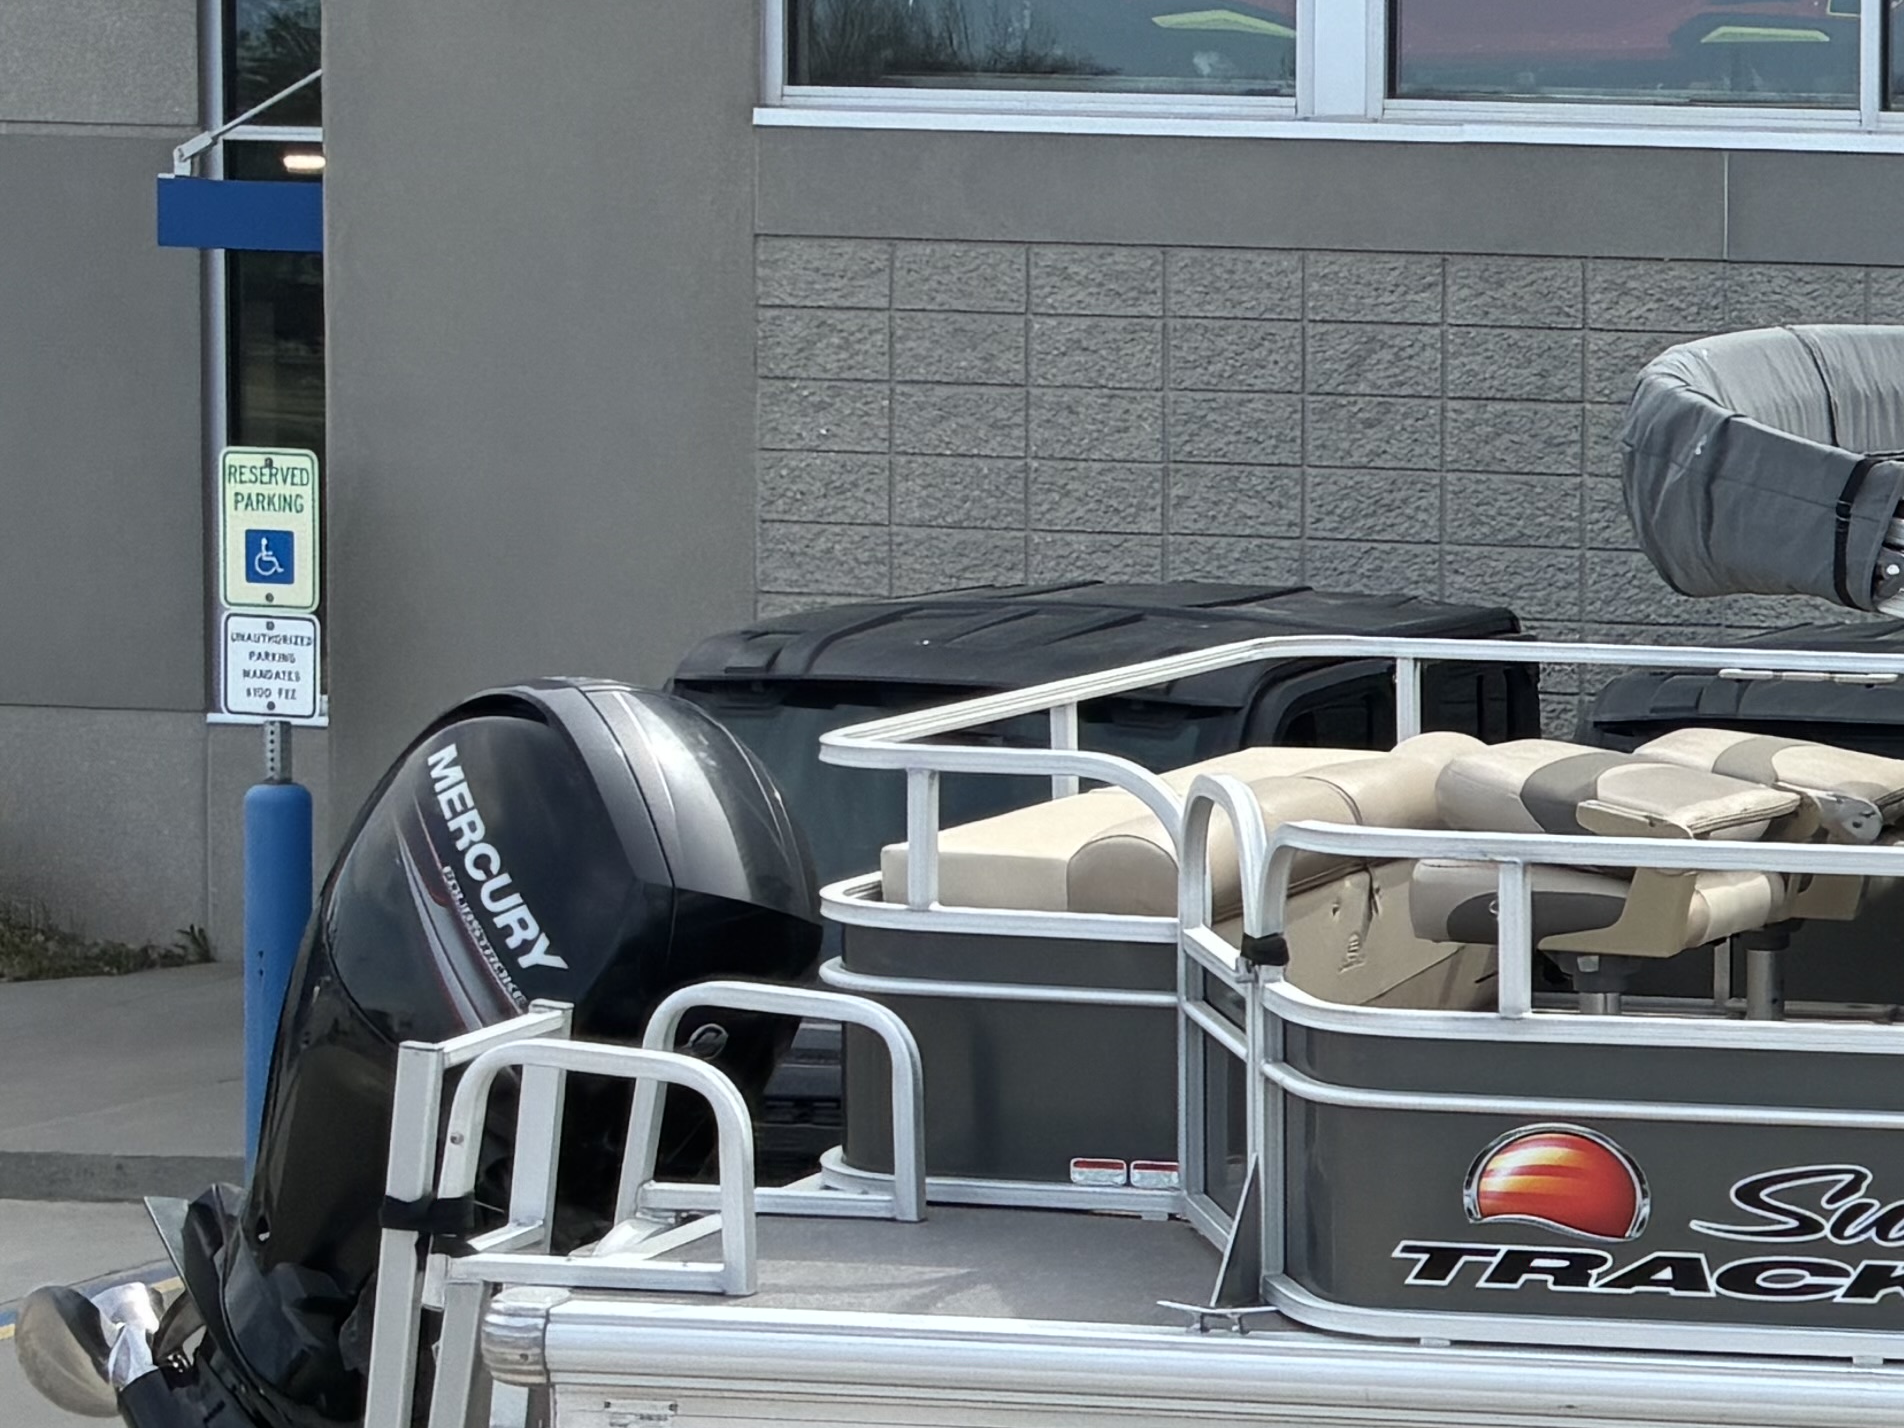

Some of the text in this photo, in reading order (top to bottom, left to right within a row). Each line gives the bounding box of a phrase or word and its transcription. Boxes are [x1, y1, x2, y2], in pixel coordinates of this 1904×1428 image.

[227, 464, 311, 487] RESERVED
[234, 493, 305, 514] PARKING
[248, 650, 296, 664] PARKING
[427, 743, 568, 971] MERCURY
